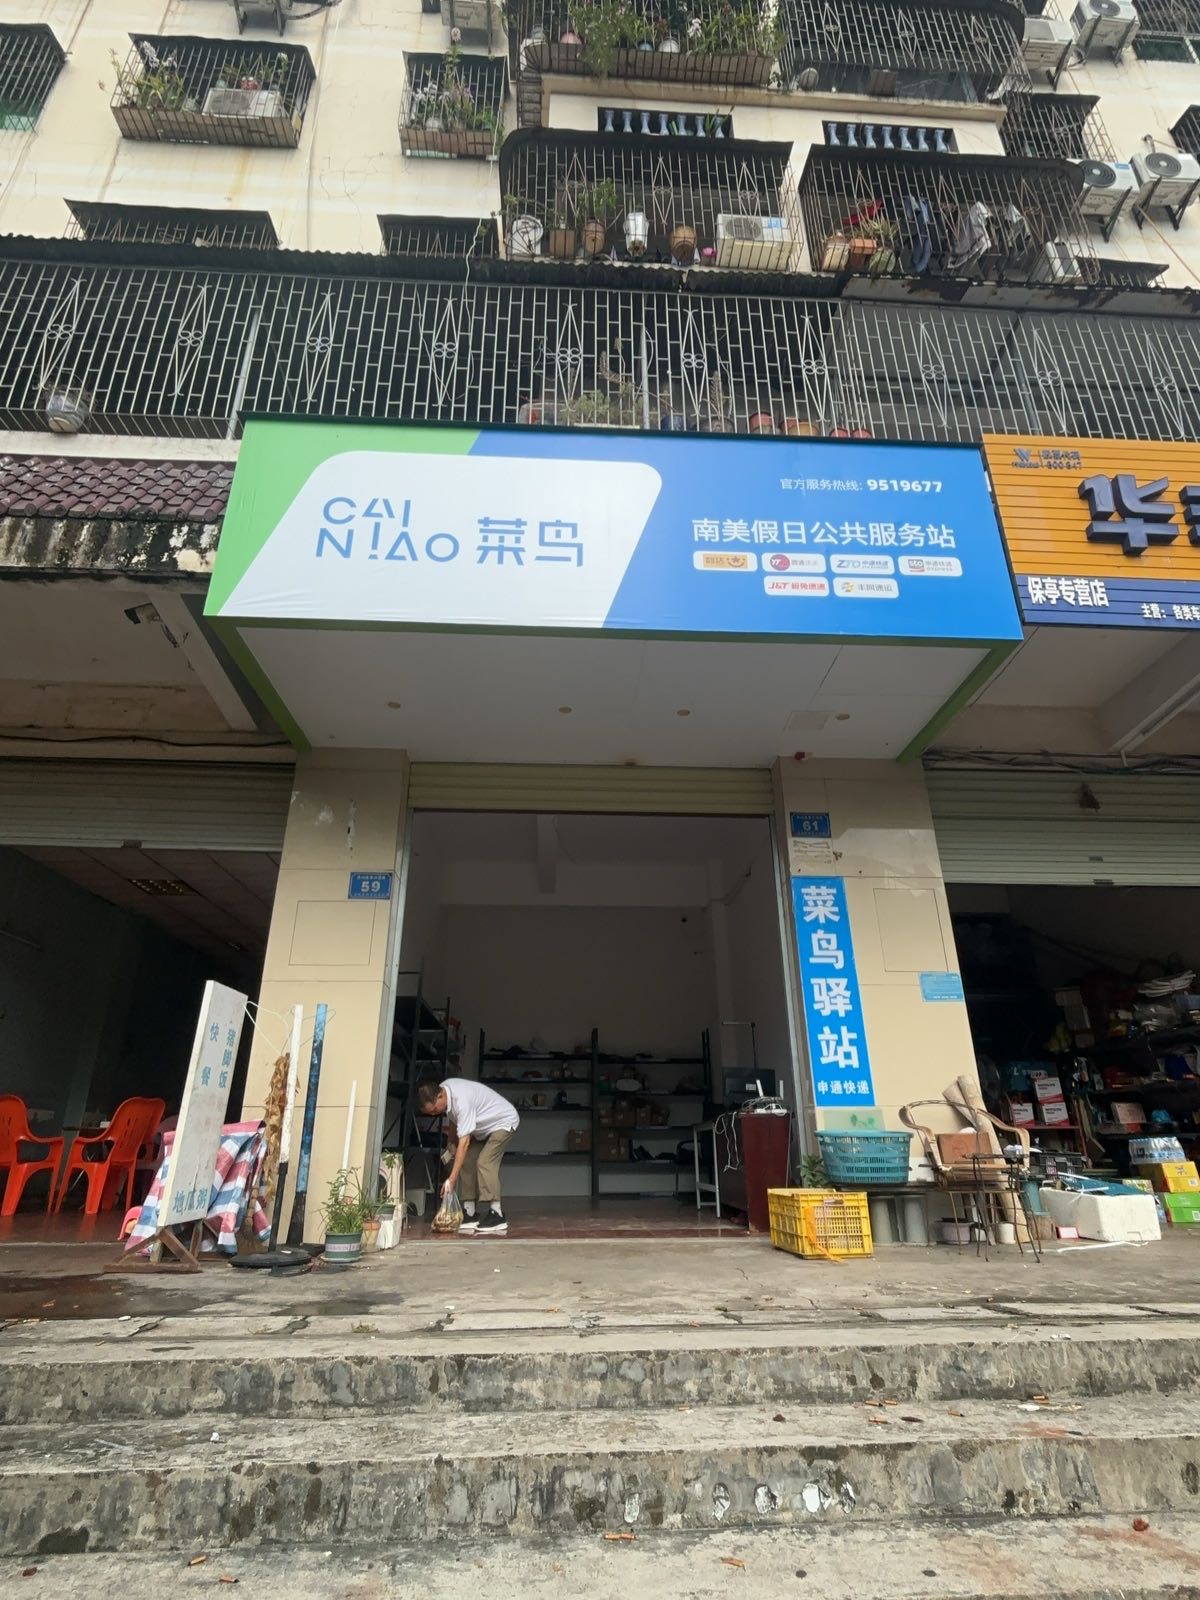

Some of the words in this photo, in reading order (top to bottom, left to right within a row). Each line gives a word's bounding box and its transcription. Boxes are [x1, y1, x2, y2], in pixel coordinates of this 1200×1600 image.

[867, 479, 943, 493] 9519677
[323, 496, 411, 527] CAI
[1078, 474, 1200, 557] 华
[476, 516, 584, 567] 菜鸟
[691, 517, 957, 549] 南美假日公共服务站
[1027, 576, 1109, 607] 保亭专营店
[802, 820, 819, 832] 61
[361, 880, 381, 893] 59
[801, 885, 860, 1069] 菜鸟驿站
[817, 1080, 870, 1095] 申通快递
